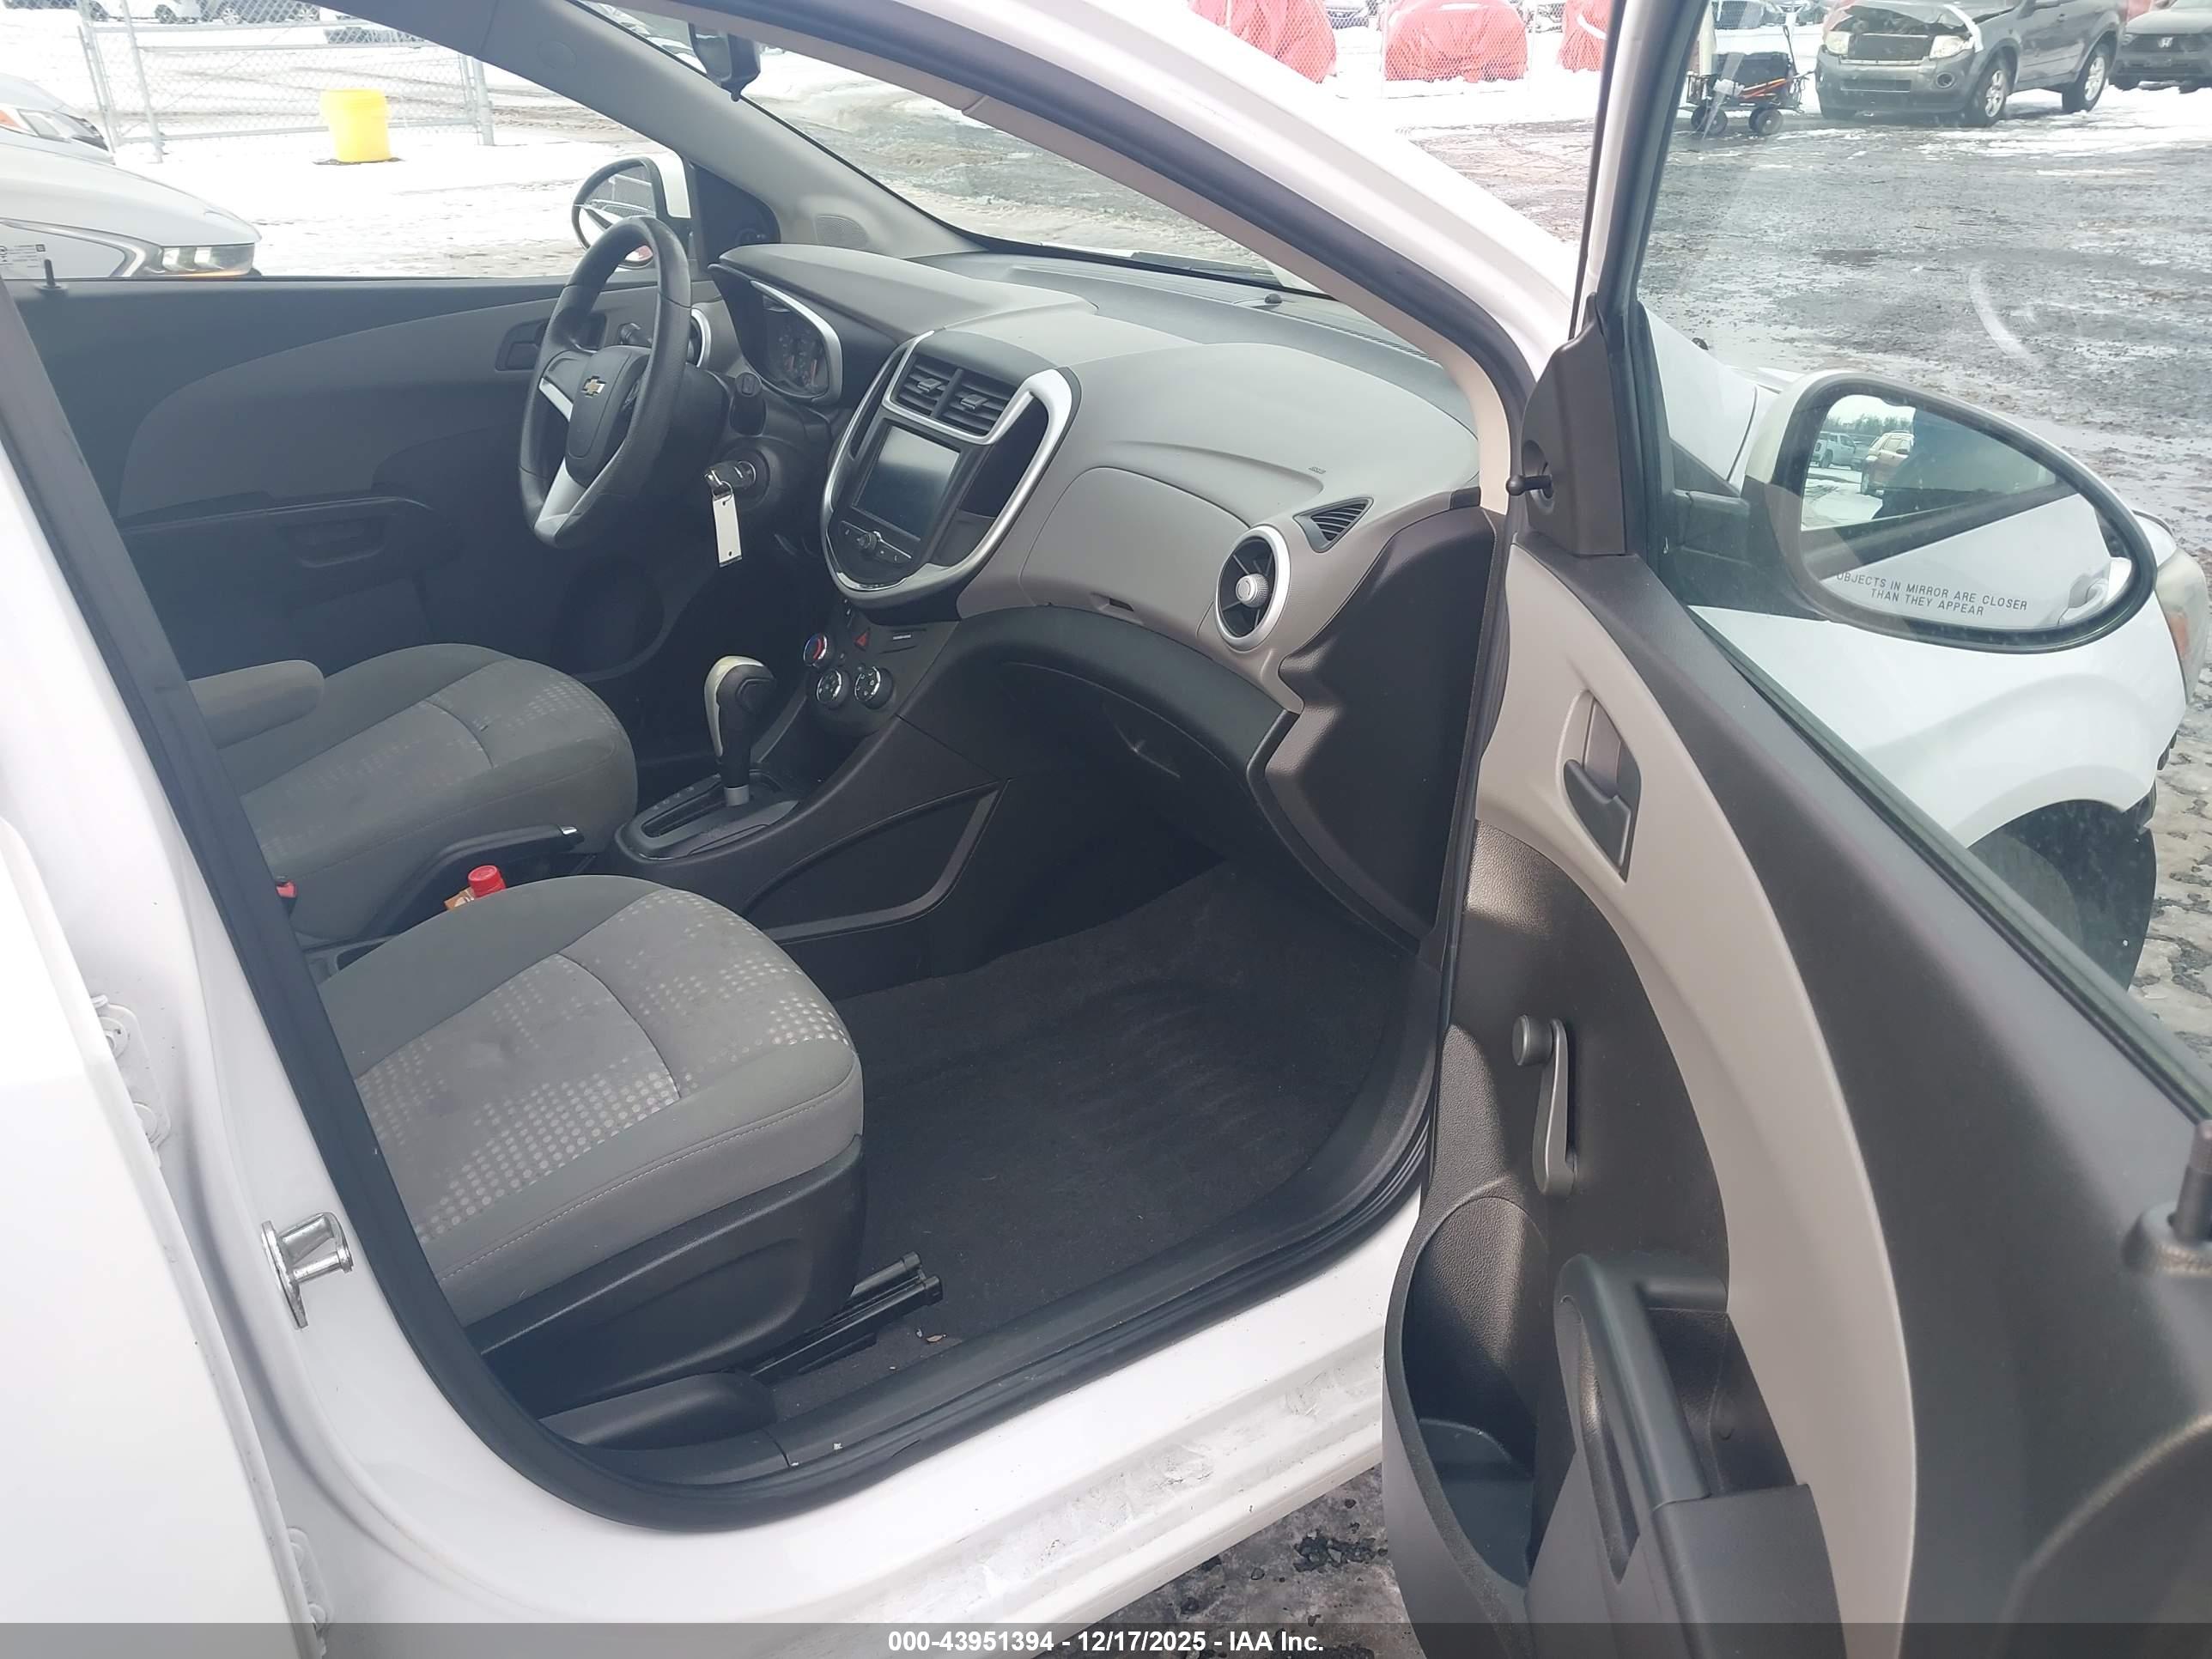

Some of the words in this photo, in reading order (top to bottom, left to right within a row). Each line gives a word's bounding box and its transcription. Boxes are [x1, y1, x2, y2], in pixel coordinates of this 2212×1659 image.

[1837, 572, 1887, 588] OBJECTS
[1890, 580, 1901, 592] IN
[1906, 583, 1949, 599] MIRROR
[1954, 591, 1977, 603] ARE
[1982, 595, 2027, 611] CLOSER
[1870, 588, 1899, 602] THAN
[1905, 593, 1934, 607] THEY
[1937, 600, 1984, 616] APPEAR
